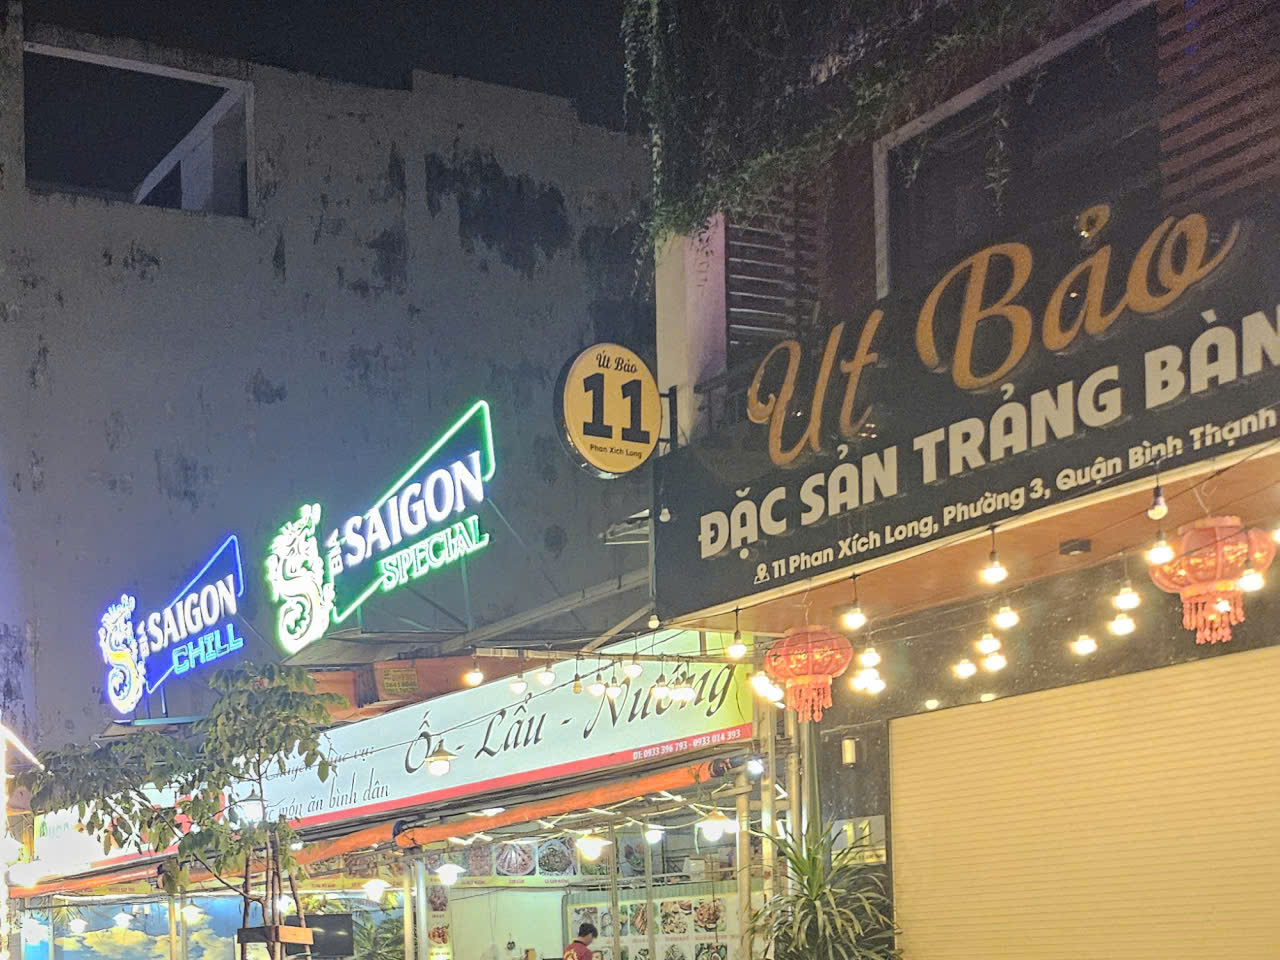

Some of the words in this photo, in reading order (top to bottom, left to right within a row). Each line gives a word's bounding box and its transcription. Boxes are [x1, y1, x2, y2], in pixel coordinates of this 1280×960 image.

[916, 204, 1240, 390] Bảo
[583, 372, 650, 444] 11
[590, 444, 608, 453] Phan
[626, 448, 642, 460] Long
[698, 487, 787, 560] ĐẶC
[800, 444, 897, 526] SẢN
[913, 365, 1122, 484] TRẢNG
[344, 450, 484, 567] SAIGON
[772, 559, 786, 578] 11
[789, 545, 833, 574] Phan
[838, 531, 880, 558] Xích
[884, 516, 939, 545] Long,
[943, 485, 1025, 526] Phường
[1030, 477, 1050, 500] 3,
[1056, 456, 1122, 490] Quận
[1129, 436, 1183, 470] Bình
[1189, 408, 1277, 450] Thạnh
[380, 514, 489, 592] SPECIAL
[148, 574, 237, 652] SAIGON
[172, 623, 244, 675] CHILL
[475, 693, 548, 759] Lẩu
[308, 795, 323, 812] ăn
[329, 772, 356, 808] bình
[363, 767, 390, 801] dân
